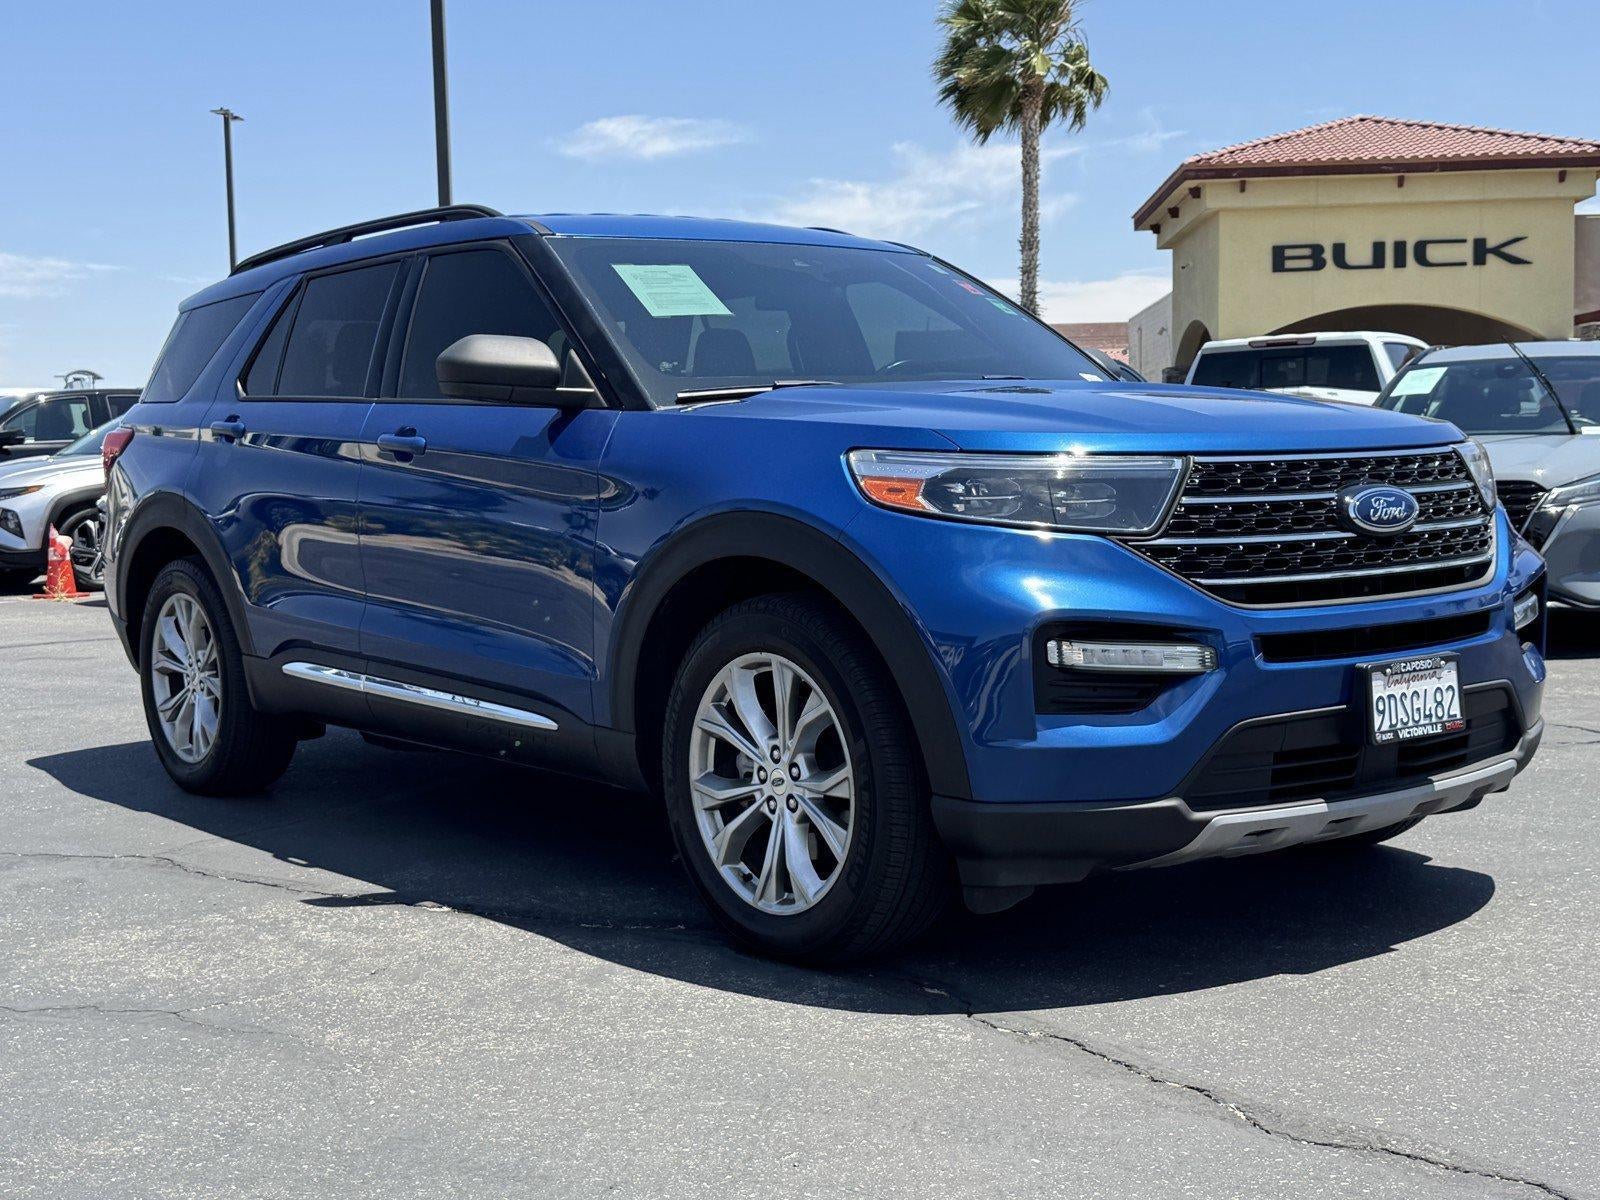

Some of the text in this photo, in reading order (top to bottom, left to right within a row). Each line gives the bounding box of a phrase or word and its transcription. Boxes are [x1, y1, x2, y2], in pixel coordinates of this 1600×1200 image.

[1272, 236, 1533, 273] BUICK
[1370, 496, 1406, 521] Ford
[1400, 659, 1432, 672] CAPOSIO
[1386, 671, 1443, 690] California
[1375, 685, 1457, 732] 9DSG482
[1398, 723, 1442, 739] VICTORVILLE
